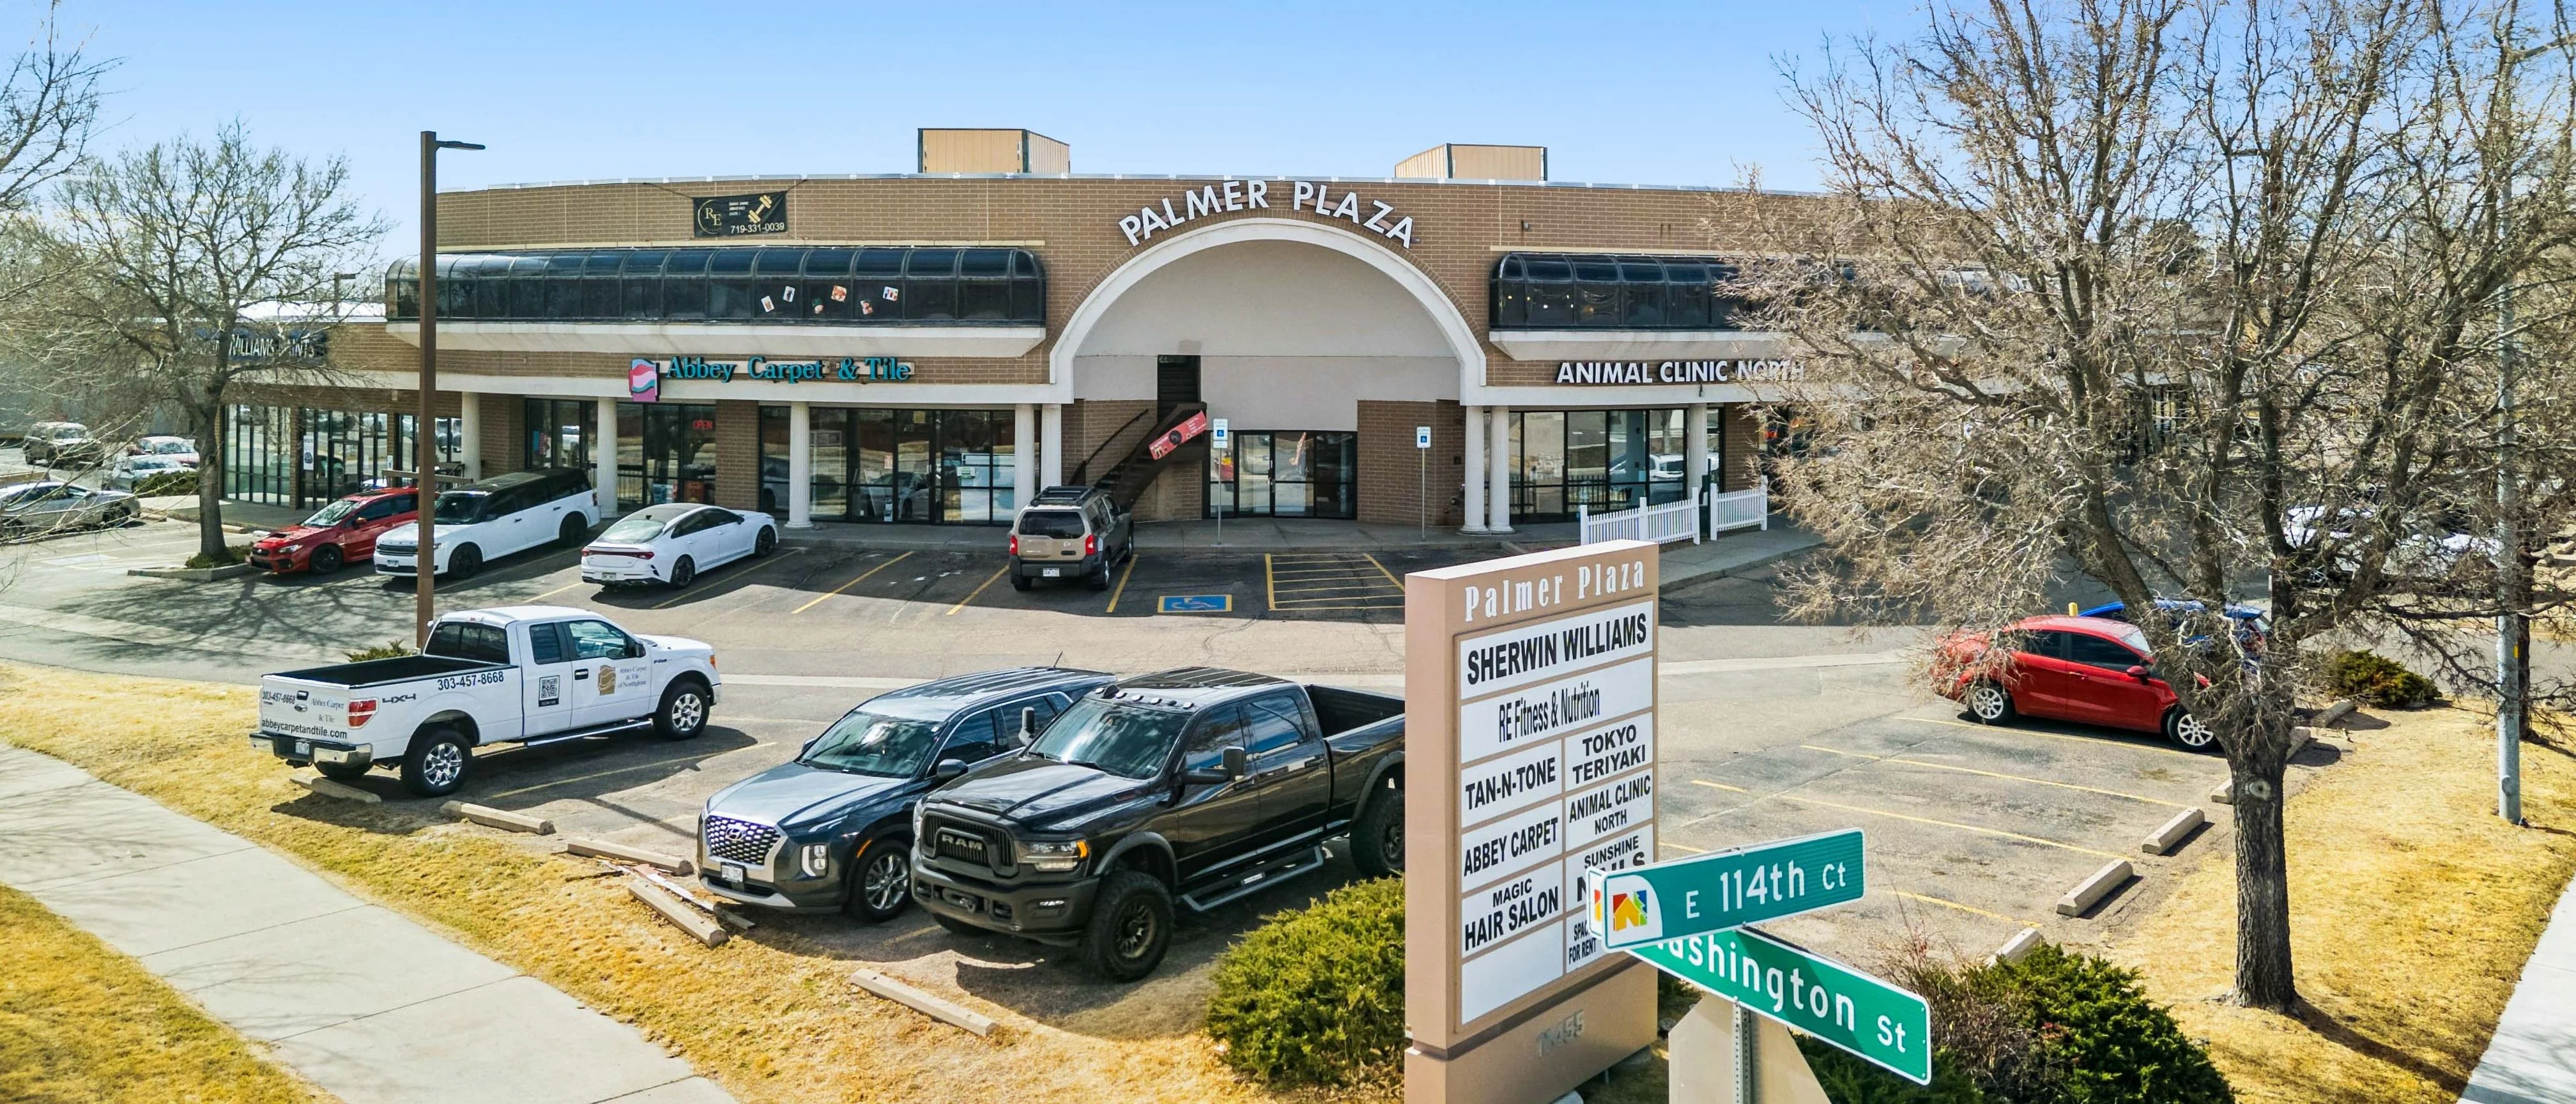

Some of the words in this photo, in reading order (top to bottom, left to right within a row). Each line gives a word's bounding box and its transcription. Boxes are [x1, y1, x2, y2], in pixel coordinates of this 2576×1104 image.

[730, 222, 785, 234] 719-331-0039
[1119, 180, 1269, 247] PALMER
[1293, 181, 1413, 249] PLAZA
[666, 356, 736, 383] Abbey
[747, 356, 825, 383] Carpet
[838, 357, 859, 381] &
[864, 357, 911, 381] Tile
[1556, 362, 1653, 383] ANIMAL
[1660, 360, 1728, 383] CLINIC
[1465, 574, 1563, 622] Palmer
[1578, 560, 1644, 599] Plaza
[1468, 632, 1557, 685] SHERWIN
[1563, 613, 1646, 662] WILLIAMS
[438, 671, 504, 691] 303-457-8668
[1499, 702, 1512, 743] RE
[1515, 697, 1549, 739] Fitness
[1551, 691, 1558, 728] &
[1561, 681, 1600, 726] Nutrition
[261, 719, 347, 739] abbeycarpetandtile.com
[1583, 724, 1637, 756] TOKYO
[1572, 744, 1646, 785] TERIYAKI
[1465, 756, 1556, 810] TAN-N-TONE
[1569, 795, 1612, 824] ANIMAL
[1615, 775, 1651, 805] CLINIC
[1595, 809, 1628, 835] NORTH
[942, 834, 983, 850] RAM
[1464, 835, 1508, 877] ABBEY
[1511, 816, 1559, 857] CARPET
[1584, 836, 1639, 869] SUNSHINE
[1492, 878, 1533, 908] MAGIC
[1686, 890, 1700, 919] E
[1720, 860, 1805, 912] 114th
[1822, 861, 1846, 891] Ct
[1465, 909, 1503, 951] HAIR
[1508, 886, 1559, 931] SALON
[1574, 919, 1590, 942] SPAC
[1569, 944, 1581, 964] FOR
[1582, 937, 1597, 958] RENT
[1657, 934, 1855, 1032] ashington
[1877, 1015, 1906, 1053] St
